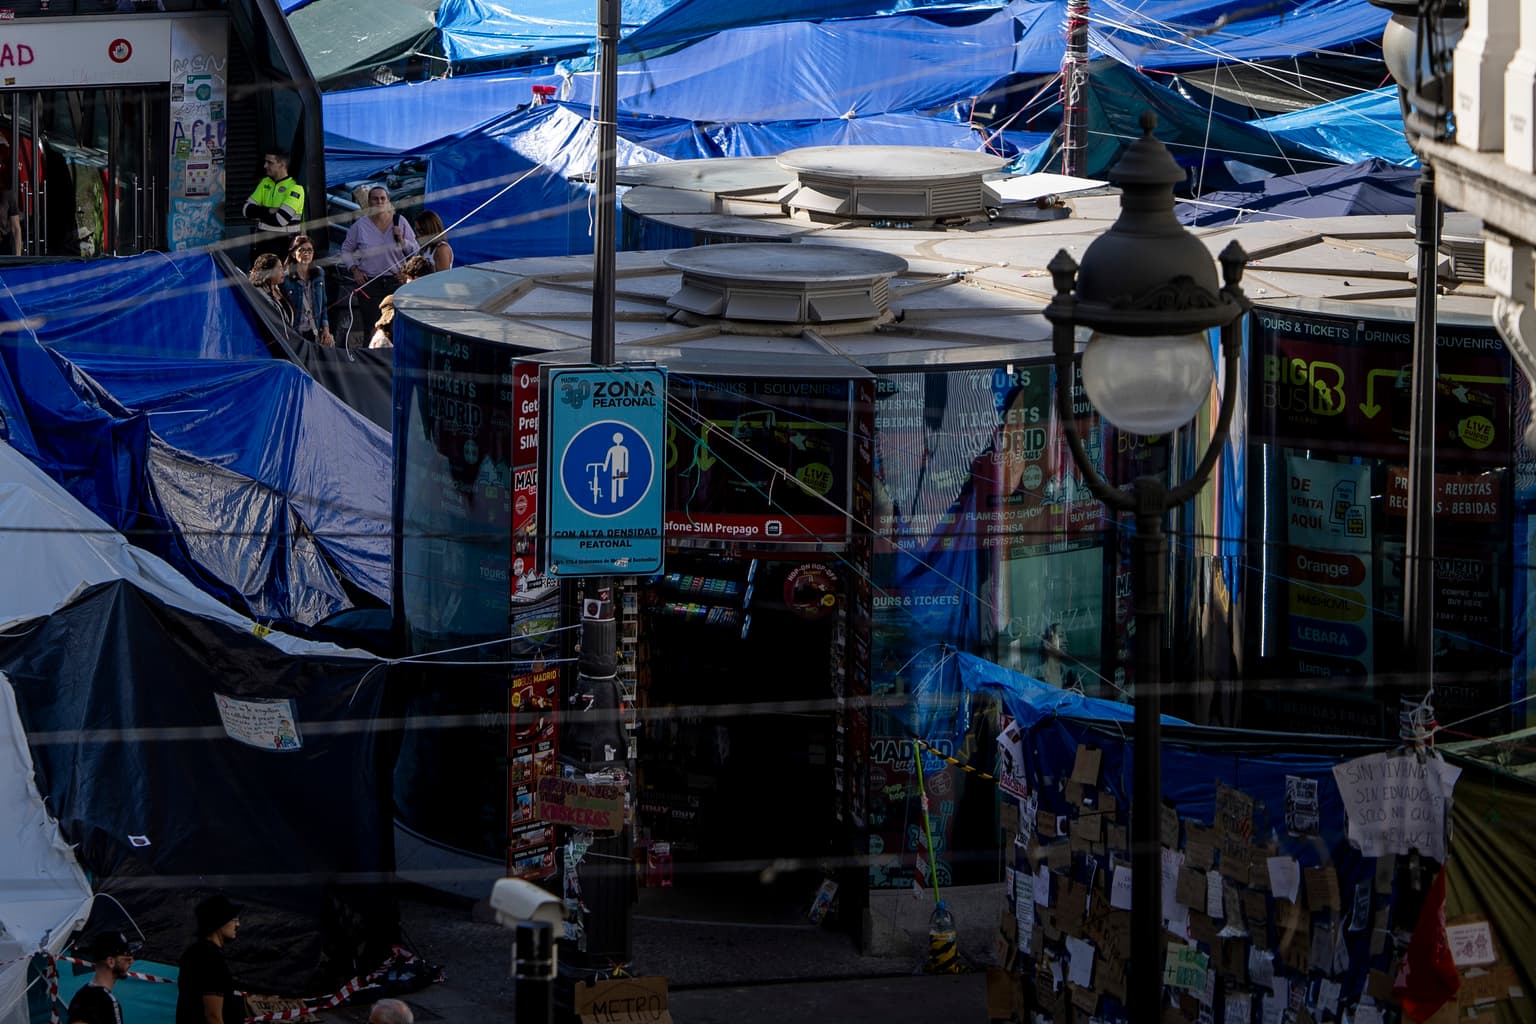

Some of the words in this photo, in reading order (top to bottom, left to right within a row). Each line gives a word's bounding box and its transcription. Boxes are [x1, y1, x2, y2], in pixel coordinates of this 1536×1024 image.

[1304, 324, 1350, 339] TICKETS
[1365, 330, 1411, 344] DRINKS
[1436, 334, 1504, 350] OUVENIRS
[1264, 354, 1308, 385] BIG
[592, 380, 657, 398] ZONA
[763, 382, 842, 395] SOUVENIRS
[592, 397, 657, 408] PEATONAL
[1465, 419, 1491, 435] LIVE
[1290, 477, 1312, 492] DE
[1444, 482, 1492, 496] REVISTAS
[1290, 495, 1324, 510] VENTA
[1451, 501, 1497, 515] BEBIDAS
[965, 508, 1015, 521] FLAMENCO
[579, 529, 604, 538] ALTA
[606, 528, 658, 537] DENSIDAD
[693, 522, 713, 533] SIM
[717, 523, 759, 535] Prepago
[986, 524, 1024, 533] PRENSA
[579, 540, 632, 549] PEATONAL
[982, 535, 1025, 547] REVISTAS
[1296, 555, 1350, 577] Orange
[914, 595, 960, 606] TICKETS
[1296, 626, 1349, 647] LEBARA
[533, 671, 557, 683] MADRID
[1347, 763, 1373, 785] SIN
[592, 994, 662, 1023] METRO
